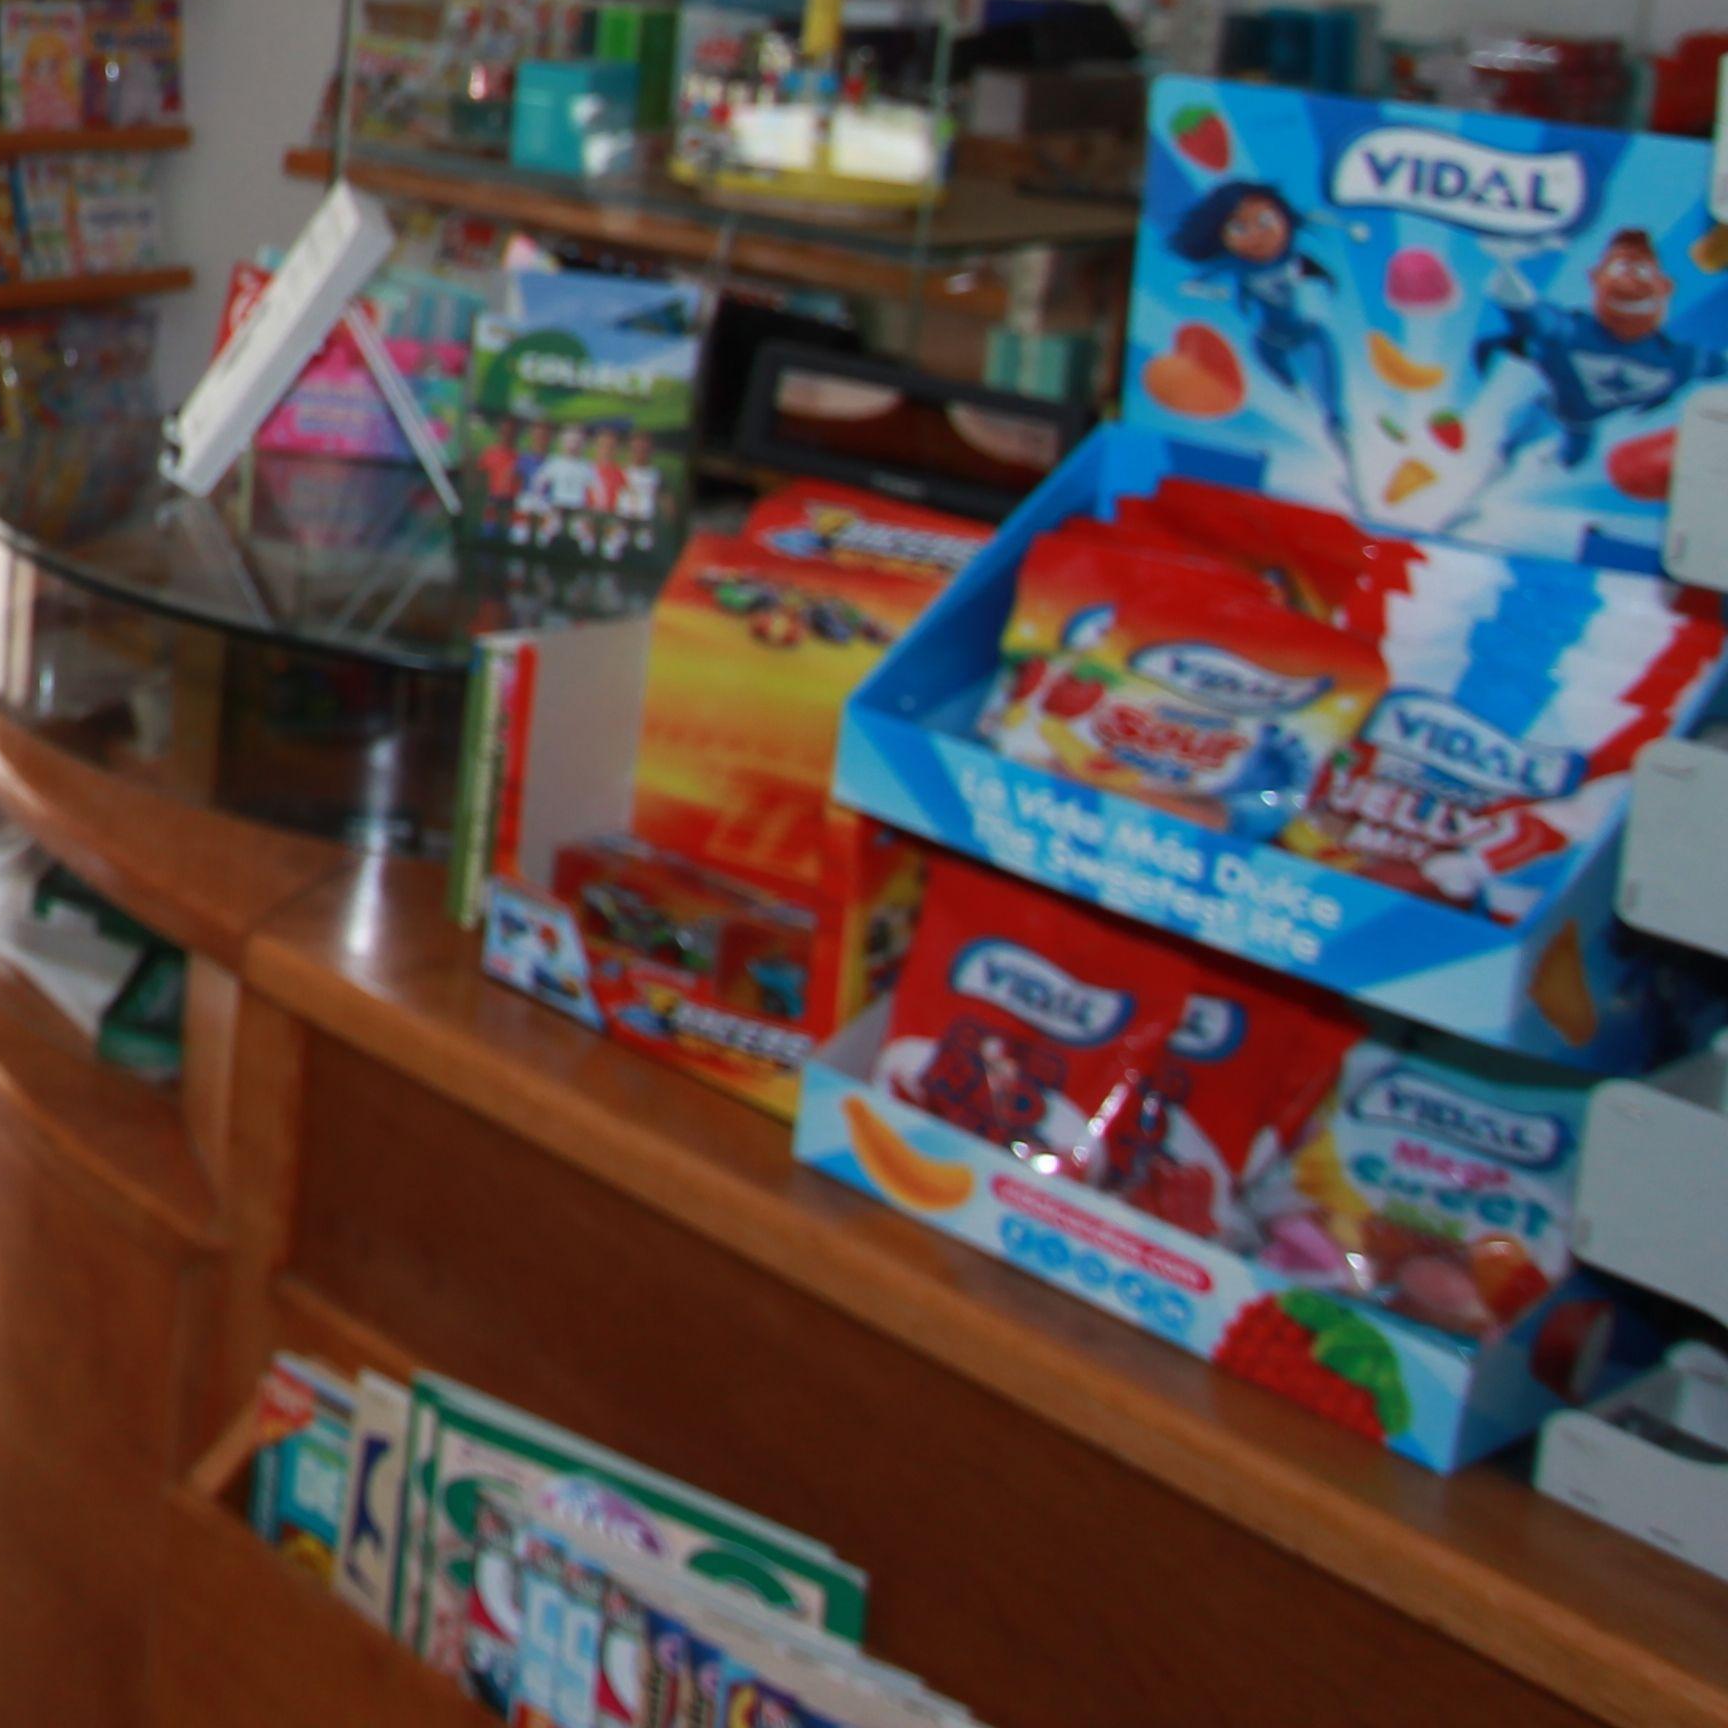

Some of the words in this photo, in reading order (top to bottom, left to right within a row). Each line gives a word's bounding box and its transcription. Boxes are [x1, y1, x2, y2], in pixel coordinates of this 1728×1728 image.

[1363, 151, 1558, 217] VIDAL
[1393, 710, 1568, 792] VIDAL
[1331, 772, 1500, 845] JELLY
[1213, 852, 1343, 928] Dulce
[979, 962, 1096, 1032] VIDAL
[1385, 1084, 1538, 1152] VIDAL
